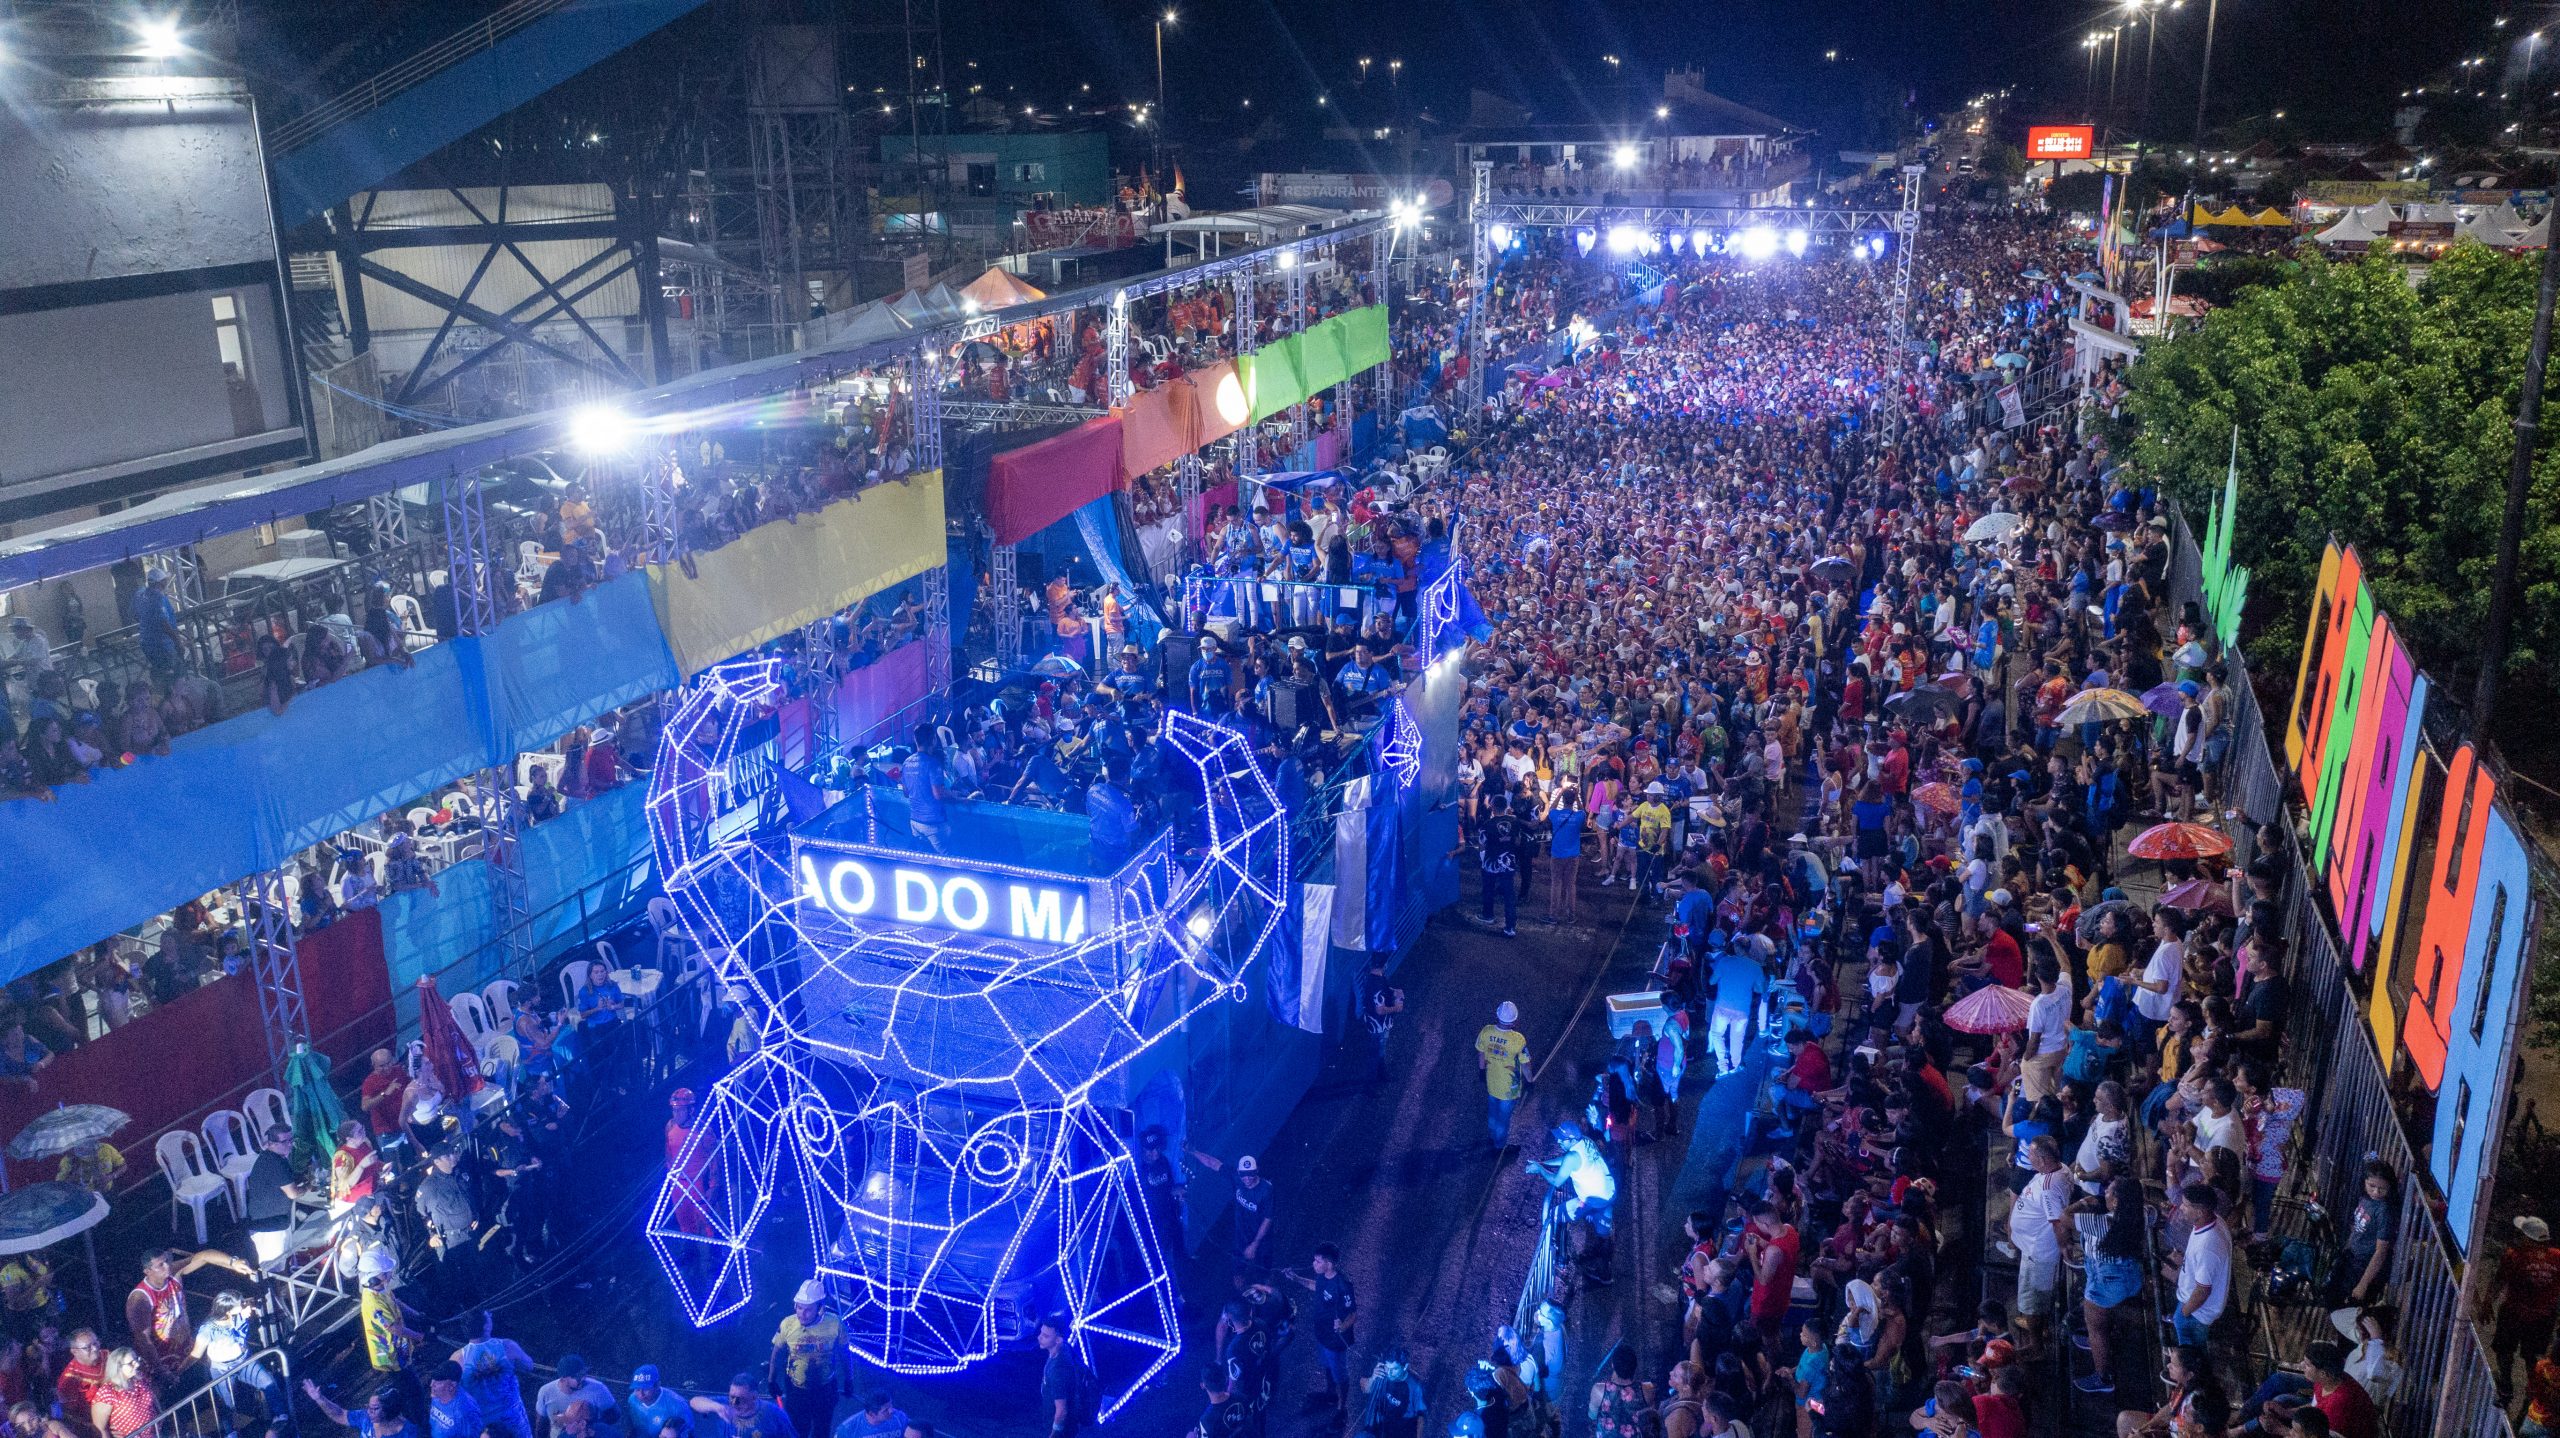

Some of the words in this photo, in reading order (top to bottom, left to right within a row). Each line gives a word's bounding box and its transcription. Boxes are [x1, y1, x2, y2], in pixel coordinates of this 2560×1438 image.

[1284, 185, 1386, 199] RESTAURANTE
[1033, 208, 1131, 234] GARANTIO
[895, 869, 990, 931] DO
[2285, 531, 2531, 1256] CARNAILHA
[1489, 1035, 1508, 1045] STAFF
